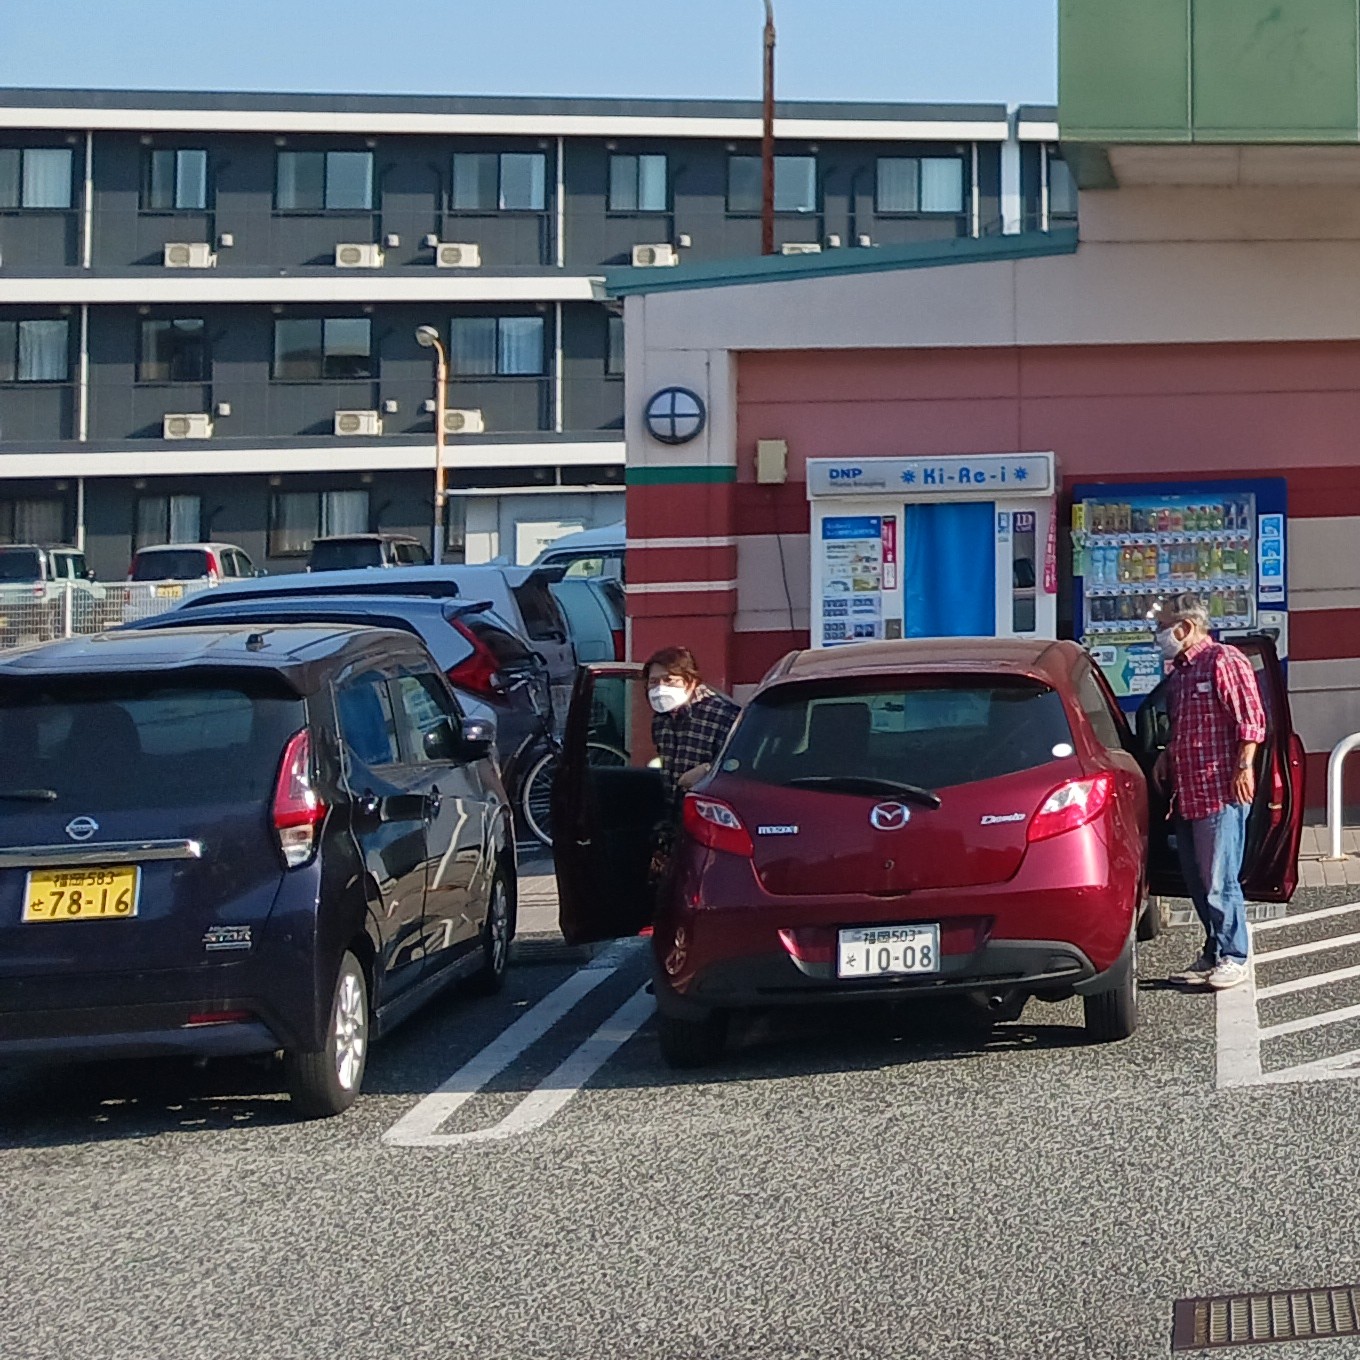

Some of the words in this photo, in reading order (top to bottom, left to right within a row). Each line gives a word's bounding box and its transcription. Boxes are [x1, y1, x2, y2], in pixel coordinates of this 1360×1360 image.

[829, 468, 862, 479] DNP
[923, 466, 1006, 484] Ki-Re-i
[49, 888, 130, 917] 78-16
[865, 945, 932, 972] 10-08
